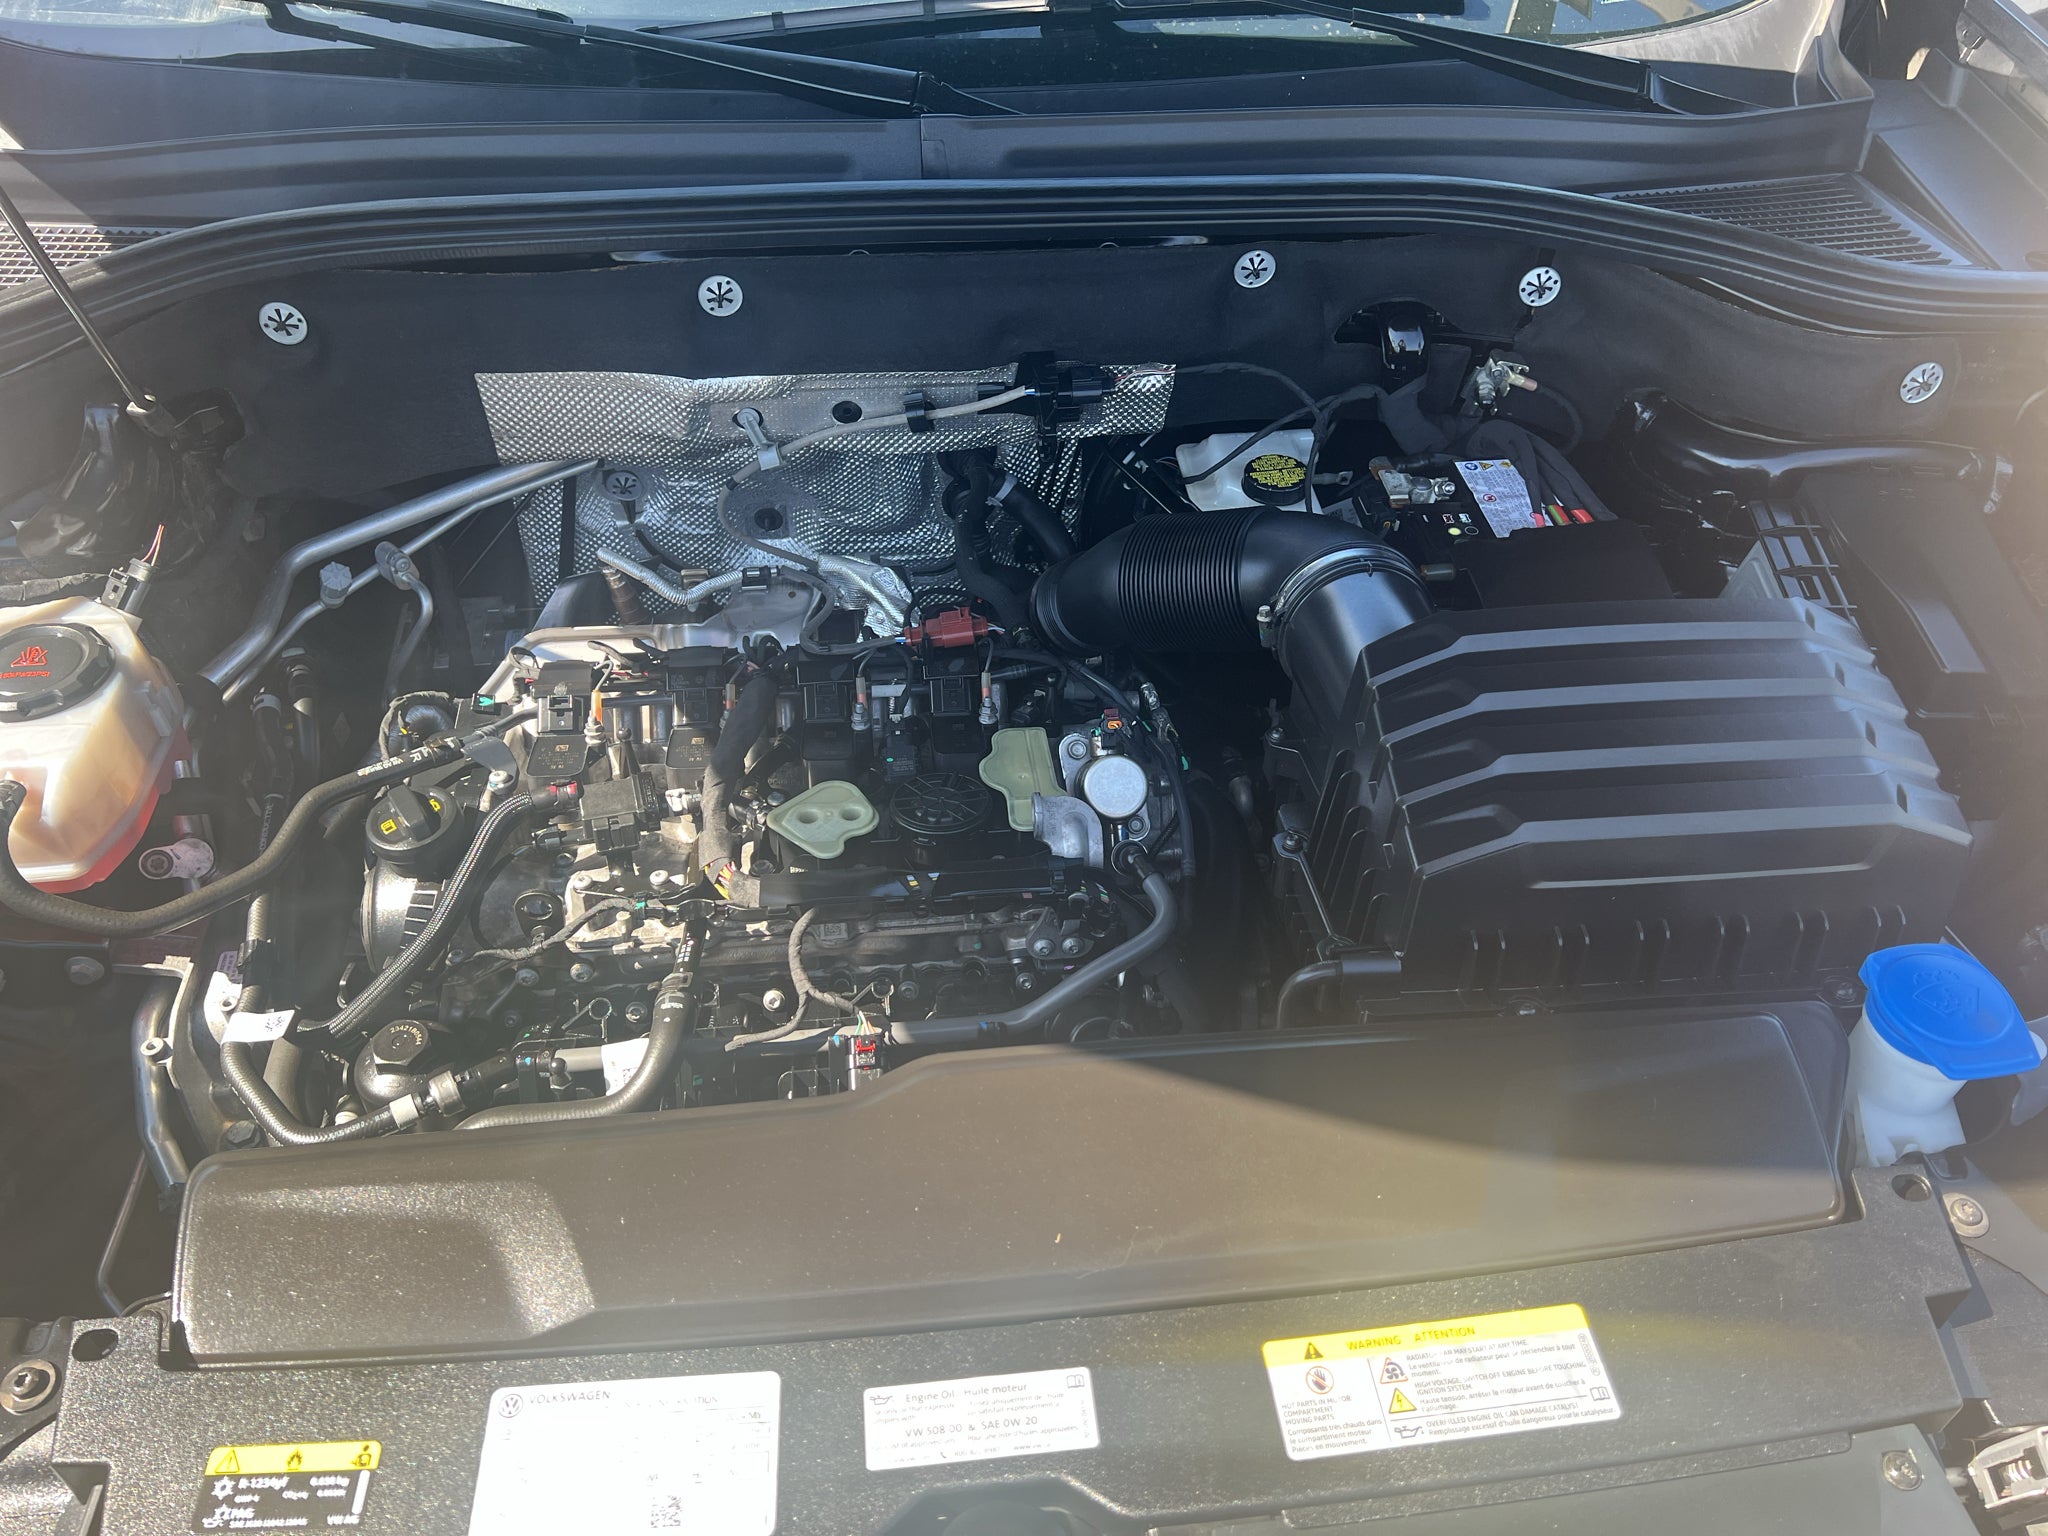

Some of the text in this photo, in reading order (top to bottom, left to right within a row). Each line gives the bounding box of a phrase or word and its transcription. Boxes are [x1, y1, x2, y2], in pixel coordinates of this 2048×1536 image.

[1347, 1326, 1475, 1350] WARNING ATTENTION
[1464, 1354, 1493, 1363] radiateur
[1502, 1369, 1526, 1377] ENGINE
[1554, 1361, 1586, 1371] TOUCHING
[529, 1390, 610, 1405] VOLKSWAGEN
[905, 1391, 938, 1405] Engine
[941, 1390, 954, 1398] Oil
[992, 1383, 1027, 1393] moteur
[1417, 1386, 1446, 1396] IGNITION
[1283, 1406, 1333, 1417] COMPARTMENT
[1467, 1413, 1491, 1422] ENGINE
[1520, 1406, 1548, 1415] DAMAGE
[1285, 1416, 1312, 1425] MOVING
[1342, 1420, 1365, 1429] chauds
[1366, 1418, 1382, 1426] dans
[1429, 1425, 1470, 1437] Remplissage
[1522, 1414, 1556, 1425] dangereux
[905, 1427, 923, 1437] VW
[927, 1425, 946, 1435] 508
[980, 1420, 1000, 1429] SAE
